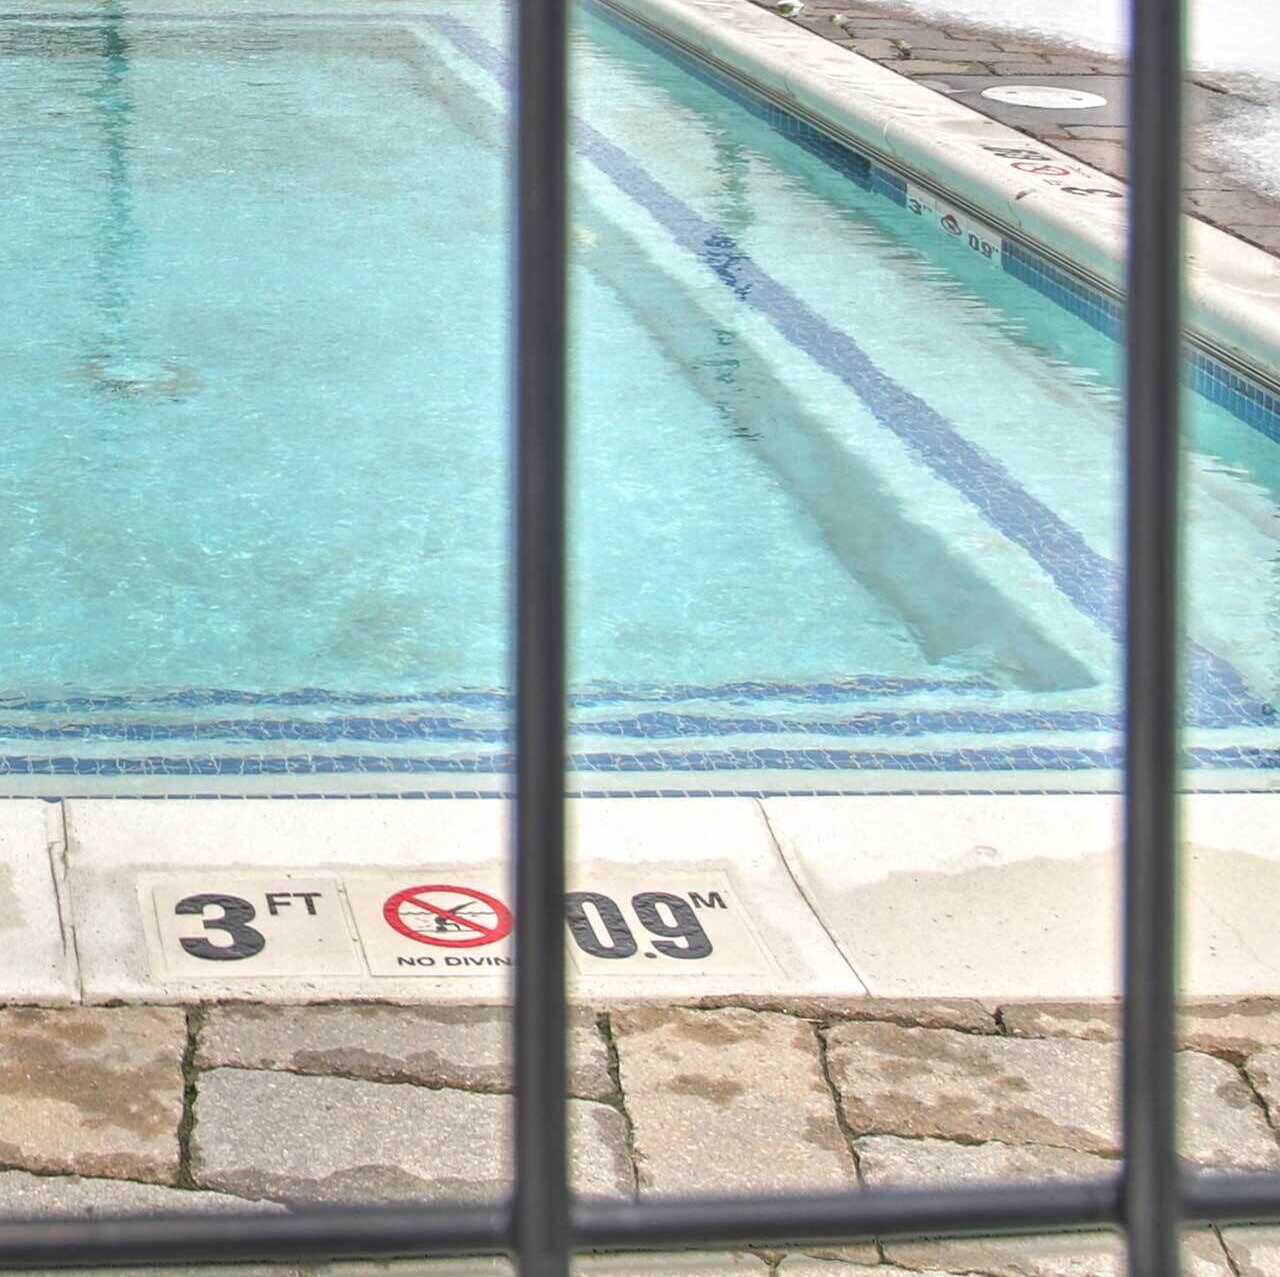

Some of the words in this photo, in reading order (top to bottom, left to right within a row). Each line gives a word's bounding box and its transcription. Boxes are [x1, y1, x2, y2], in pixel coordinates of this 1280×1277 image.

[688, 891, 728, 909] M
[175, 893, 266, 961] 3
[265, 892, 322, 916] FT
[397, 956, 436, 967] NO
[443, 956, 514, 967] DIVIN
